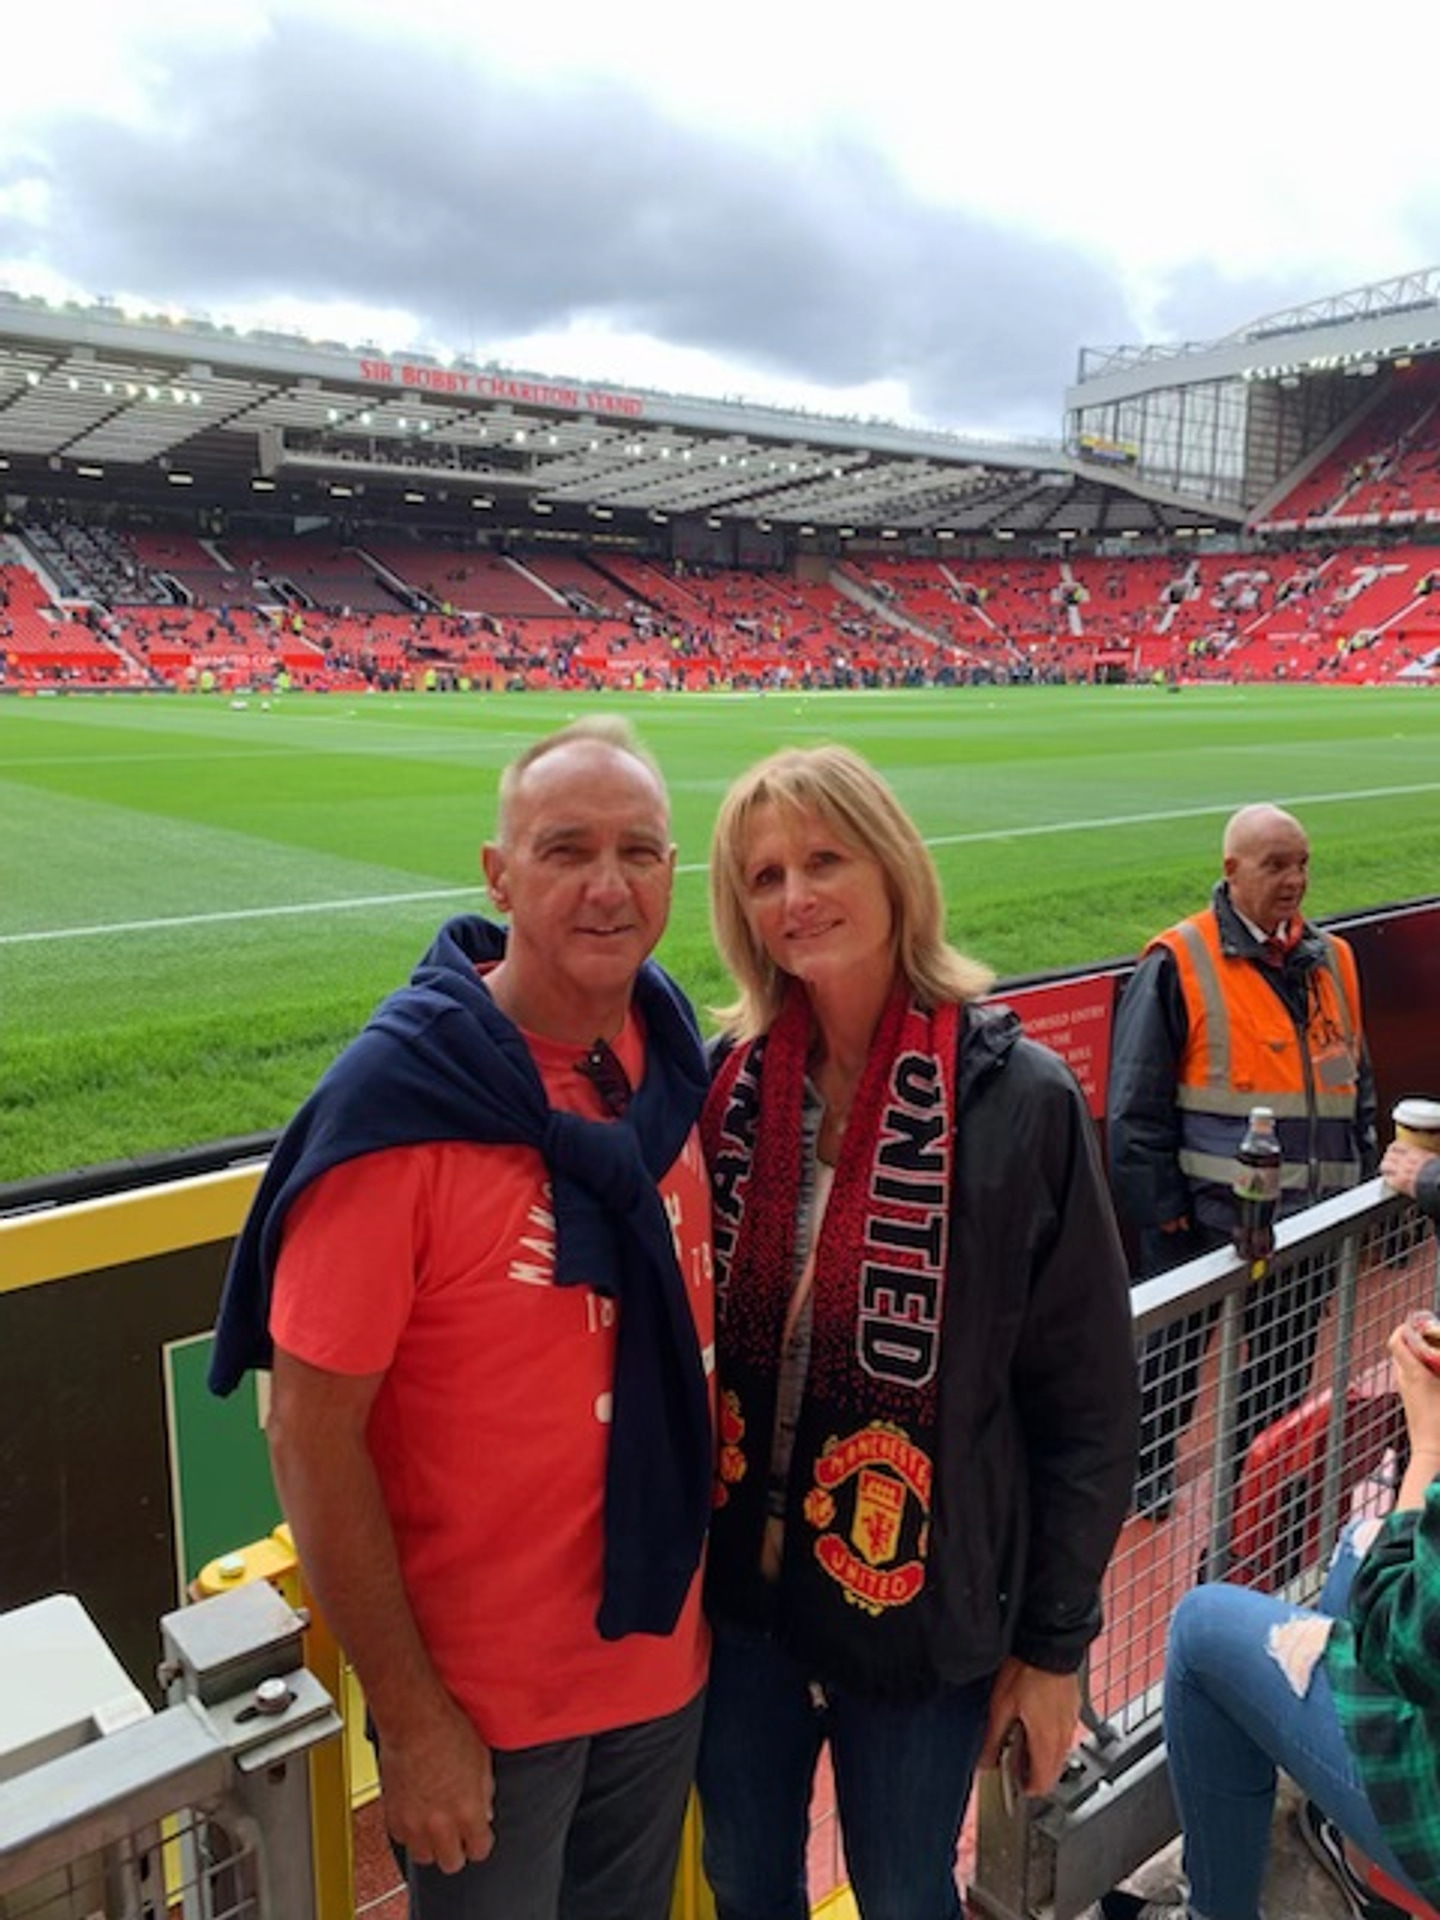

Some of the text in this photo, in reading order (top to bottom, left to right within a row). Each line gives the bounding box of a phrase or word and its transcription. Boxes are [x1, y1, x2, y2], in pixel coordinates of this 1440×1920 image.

[359, 360, 393, 382] SIR
[402, 366, 470, 392] BOBBY
[587, 391, 644, 416] STAND
[856, 1050, 949, 1389] UNITED
[828, 1434, 931, 1488] MANCHESTE
[830, 1553, 908, 1599] UNITED
